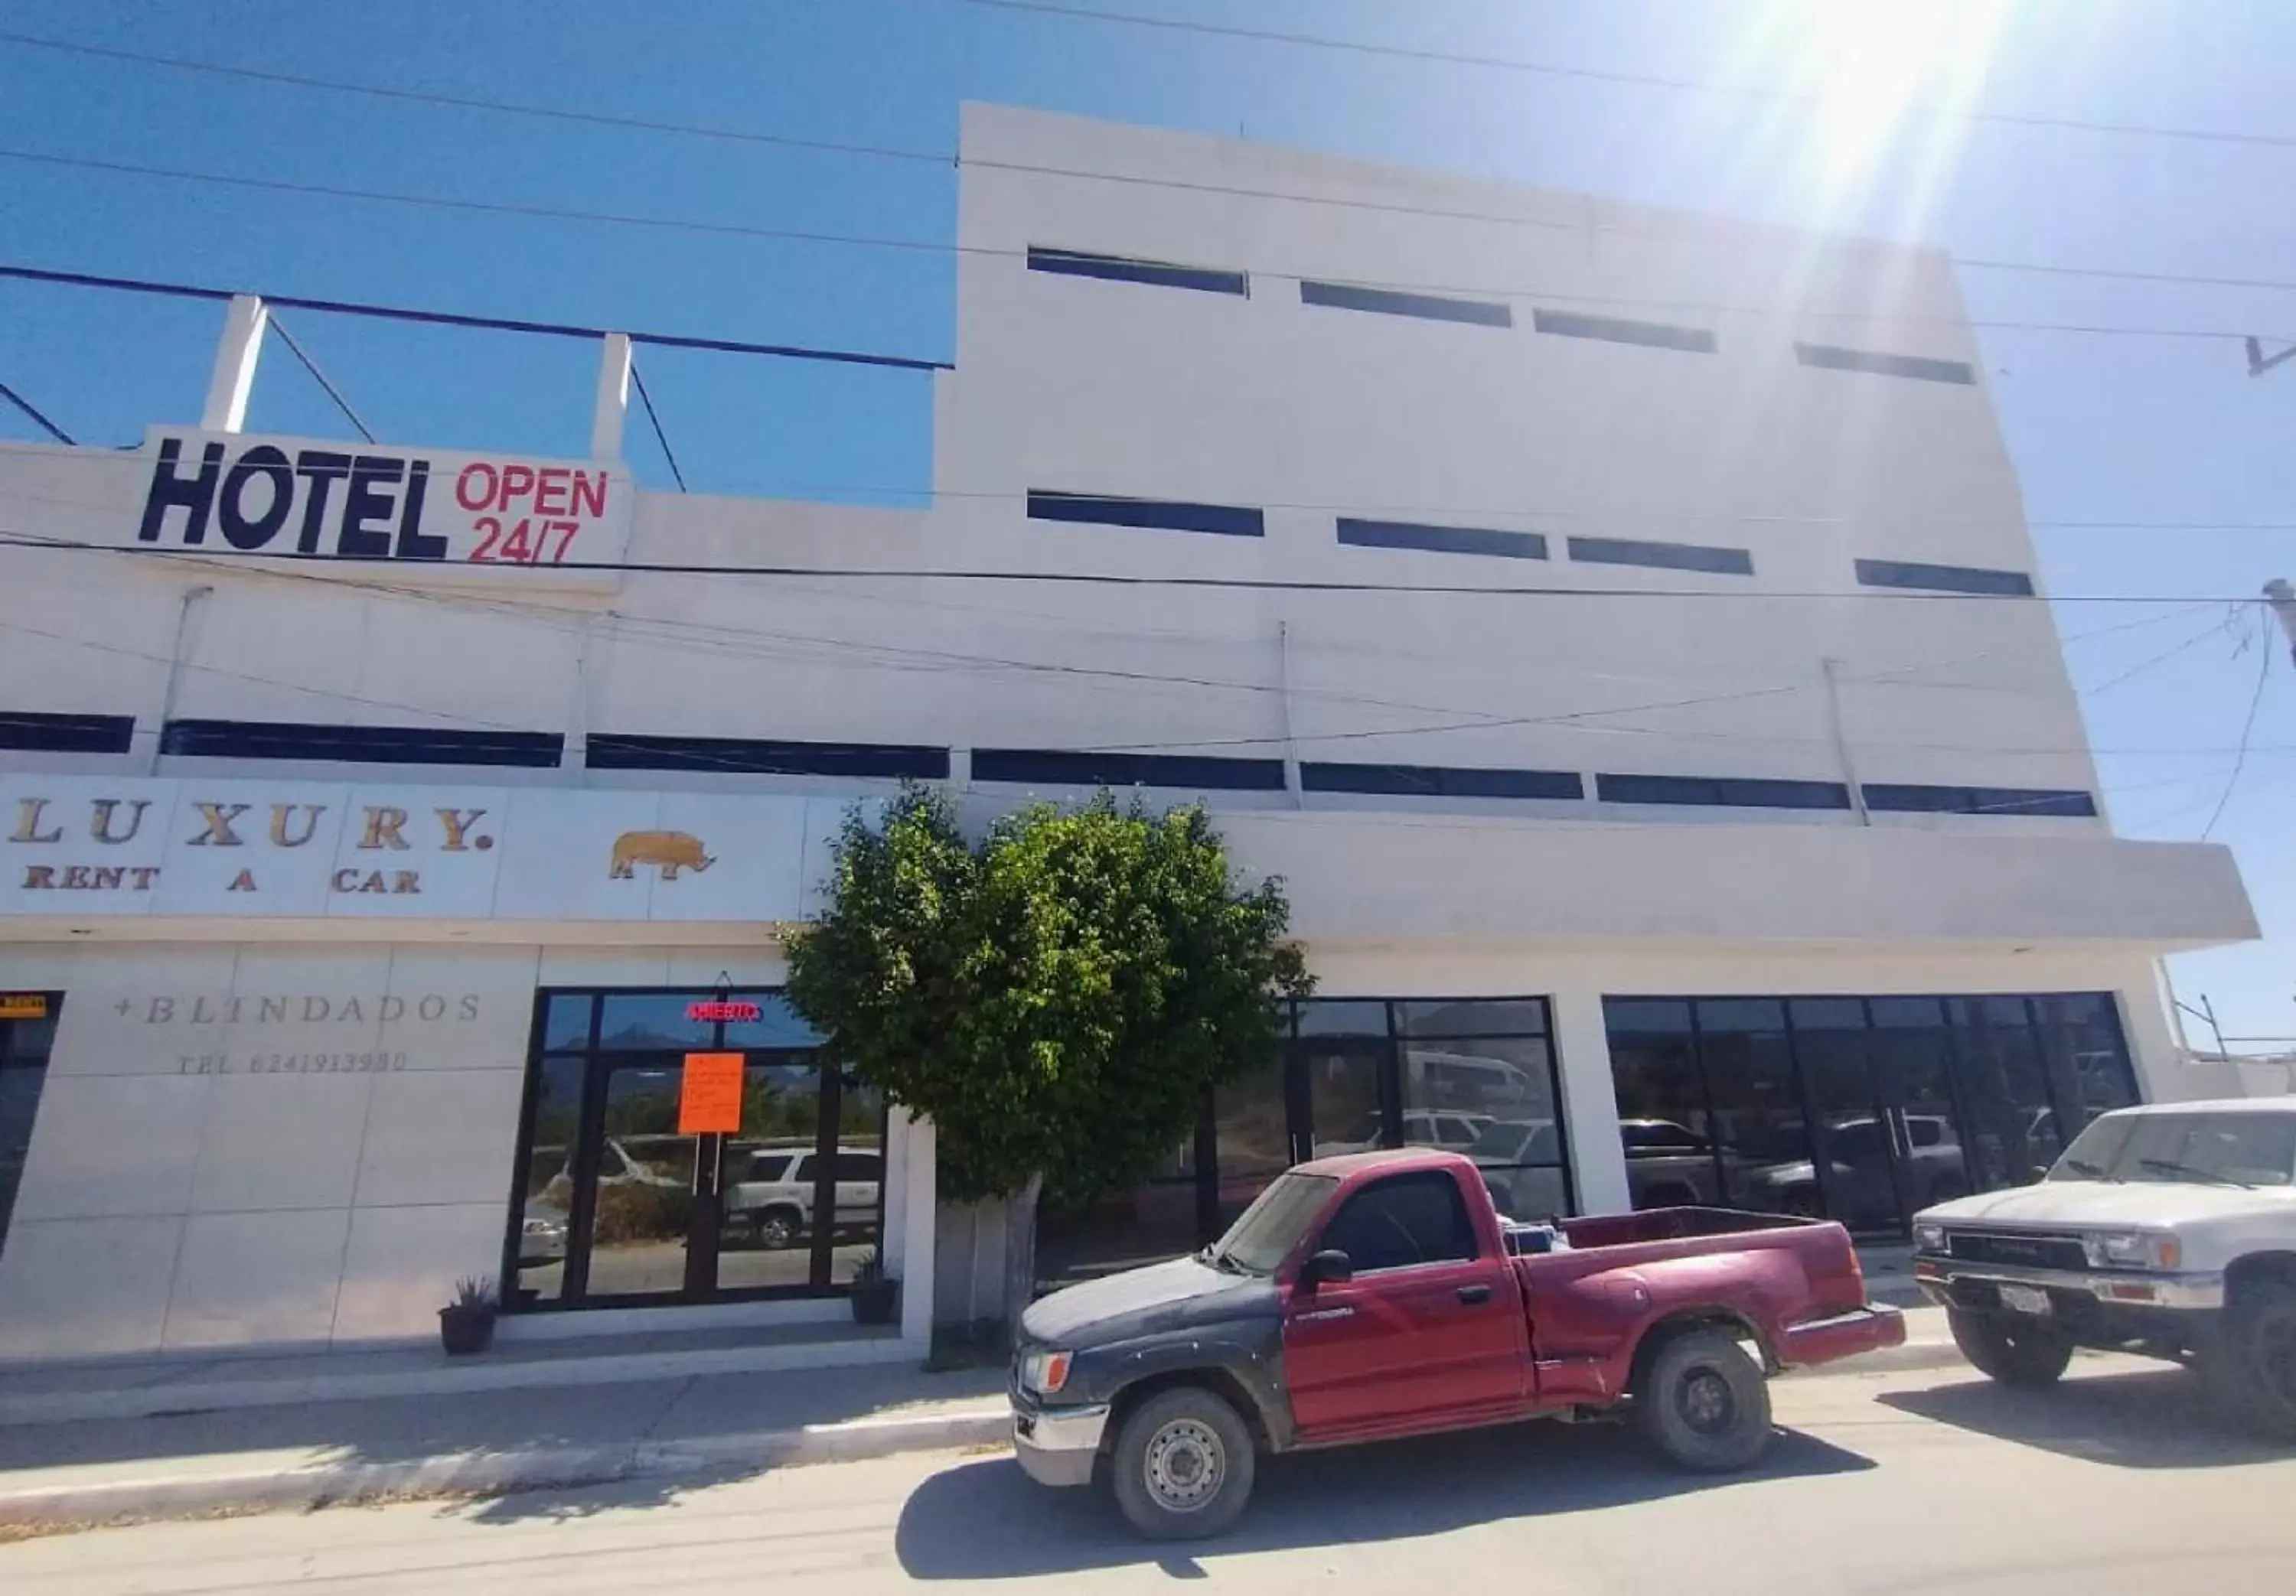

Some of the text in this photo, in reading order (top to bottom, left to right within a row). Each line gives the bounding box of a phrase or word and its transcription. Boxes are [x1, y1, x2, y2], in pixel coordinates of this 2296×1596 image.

[138, 438, 448, 559] HOTEL
[456, 462, 608, 518] OPEN
[468, 516, 580, 567] 24/7
[21, 865, 422, 894] RENT A CAR
[177, 1053, 231, 1074] TEL
